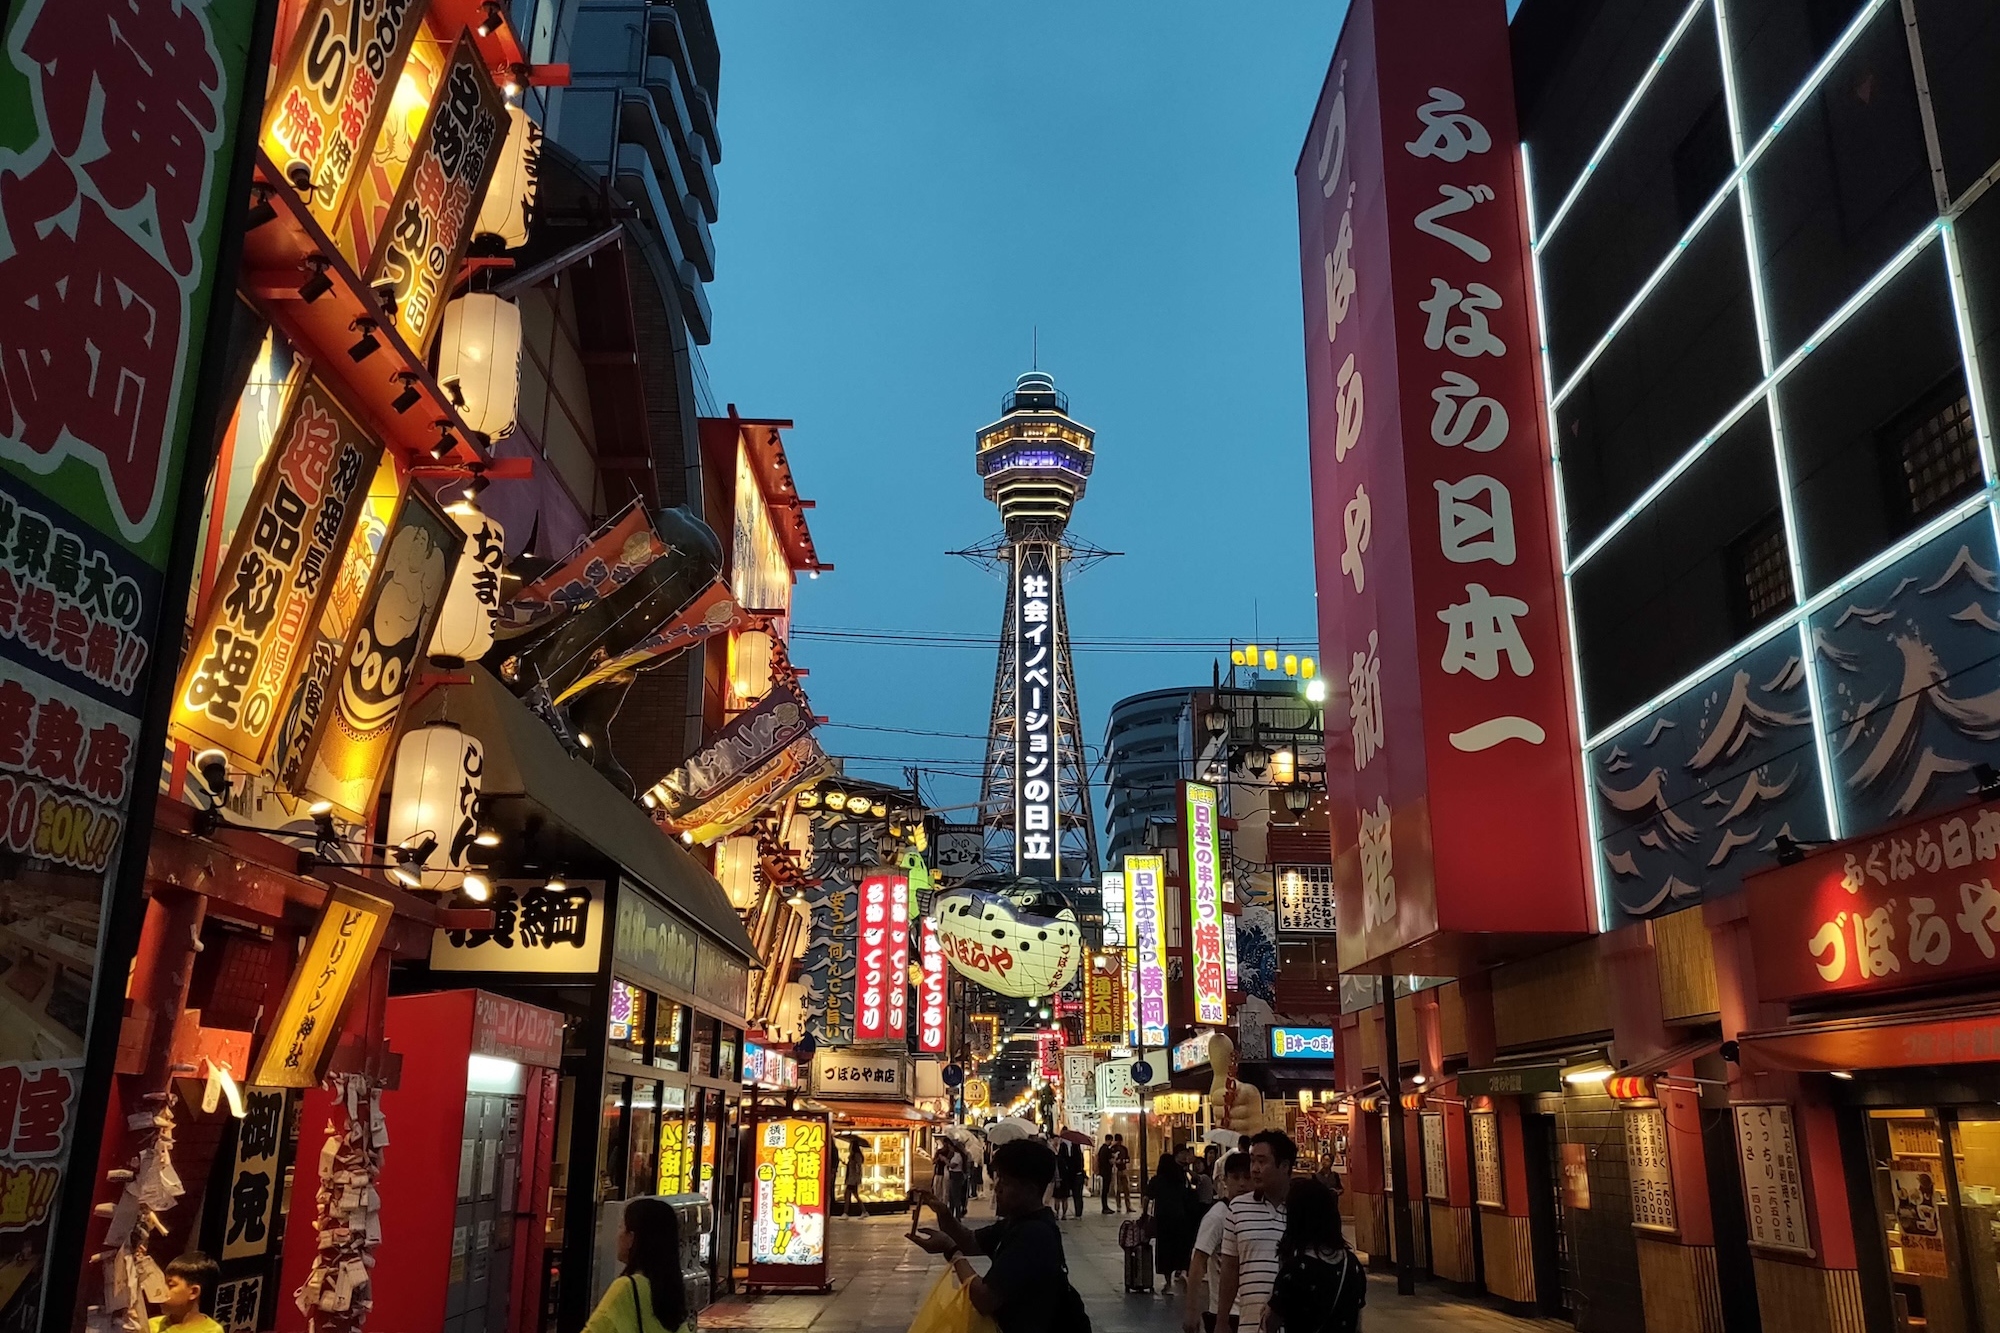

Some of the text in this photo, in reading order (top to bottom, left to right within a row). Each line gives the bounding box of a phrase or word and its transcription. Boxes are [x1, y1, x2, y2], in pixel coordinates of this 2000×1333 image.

[384, 65, 479, 300] 名物串かつ
[1404, 87, 1546, 752] ふぐなら日本一
[1319, 59, 1397, 933] づぼらや新館
[187, 400, 338, 726] 逸品料理
[246, 445, 362, 735] 料理長自慢の
[1023, 575, 1050, 860] 社会イノベーションの日立
[1193, 805, 1215, 919] 日本一の串かつ
[866, 884, 884, 923] 名物
[1135, 873, 1157, 962] 日本一の串かつ
[1312, 897, 1322, 928] にんにく
[1321, 897, 1332, 928] 玉ねぎ
[941, 931, 1013, 978] づぼらや
[1194, 922, 1223, 999] 横綱
[1092, 976, 1112, 1032] 通天閣
[1112, 976, 1120, 1032] TSUTENKAKU
[1201, 1004, 1222, 1020] 酒処
[824, 1066, 895, 1083] づぼらや本店
[772, 1148, 797, 1255] 営業中!!
[794, 1125, 824, 1206] 24時間
